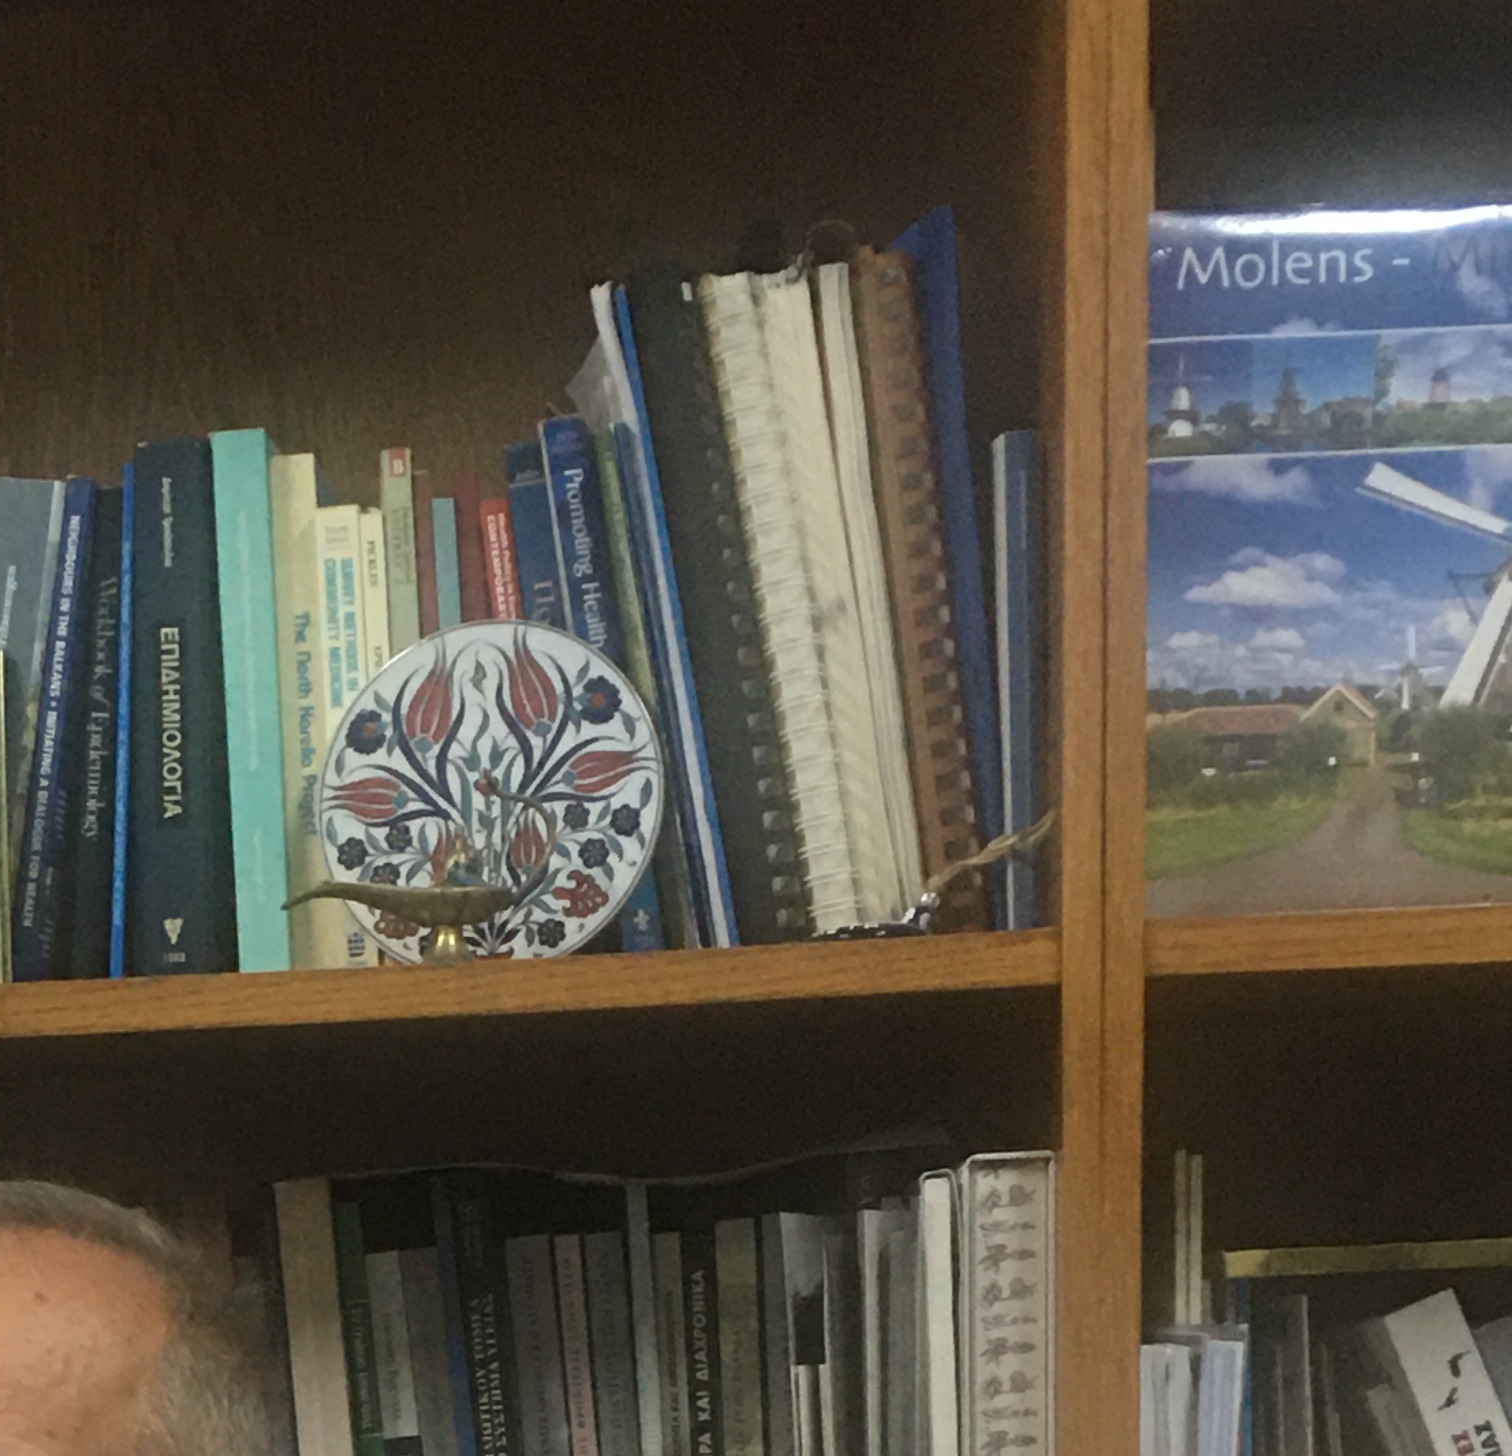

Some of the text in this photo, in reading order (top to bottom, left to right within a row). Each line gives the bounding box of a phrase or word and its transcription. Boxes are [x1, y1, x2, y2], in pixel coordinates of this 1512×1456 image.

[1178, 239, 1375, 291] Molens
[563, 467, 608, 649] Promoting Health
[294, 611, 311, 644] The
[323, 557, 340, 641] COMMUNITY
[344, 611, 359, 674] METHODS
[296, 651, 314, 699] North
[328, 646, 344, 709] MEDICINE
[22, 514, 82, 928] NEIGHBOURS IN THE BALKANS INITIATING A DIALOGUE FOR HEALTH
[81, 576, 118, 839] Workbook of Epidemiology
[160, 627, 182, 819] ΕΠΙΔΗΜΙΟΛΟΓΙΑ
[297, 774, 319, 836] Project
[469, 1298, 485, 1361] ΤΟΜΕΑ
[482, 1293, 498, 1356] ΥΓΕΙΑΣ
[691, 1269, 709, 1381] ΔΙΑΧΡΟΝΙΚΑ
[489, 1361, 507, 1447] ΣΥΣΤΗΜΑ
[696, 1391, 712, 1421] ΚΑΙ
